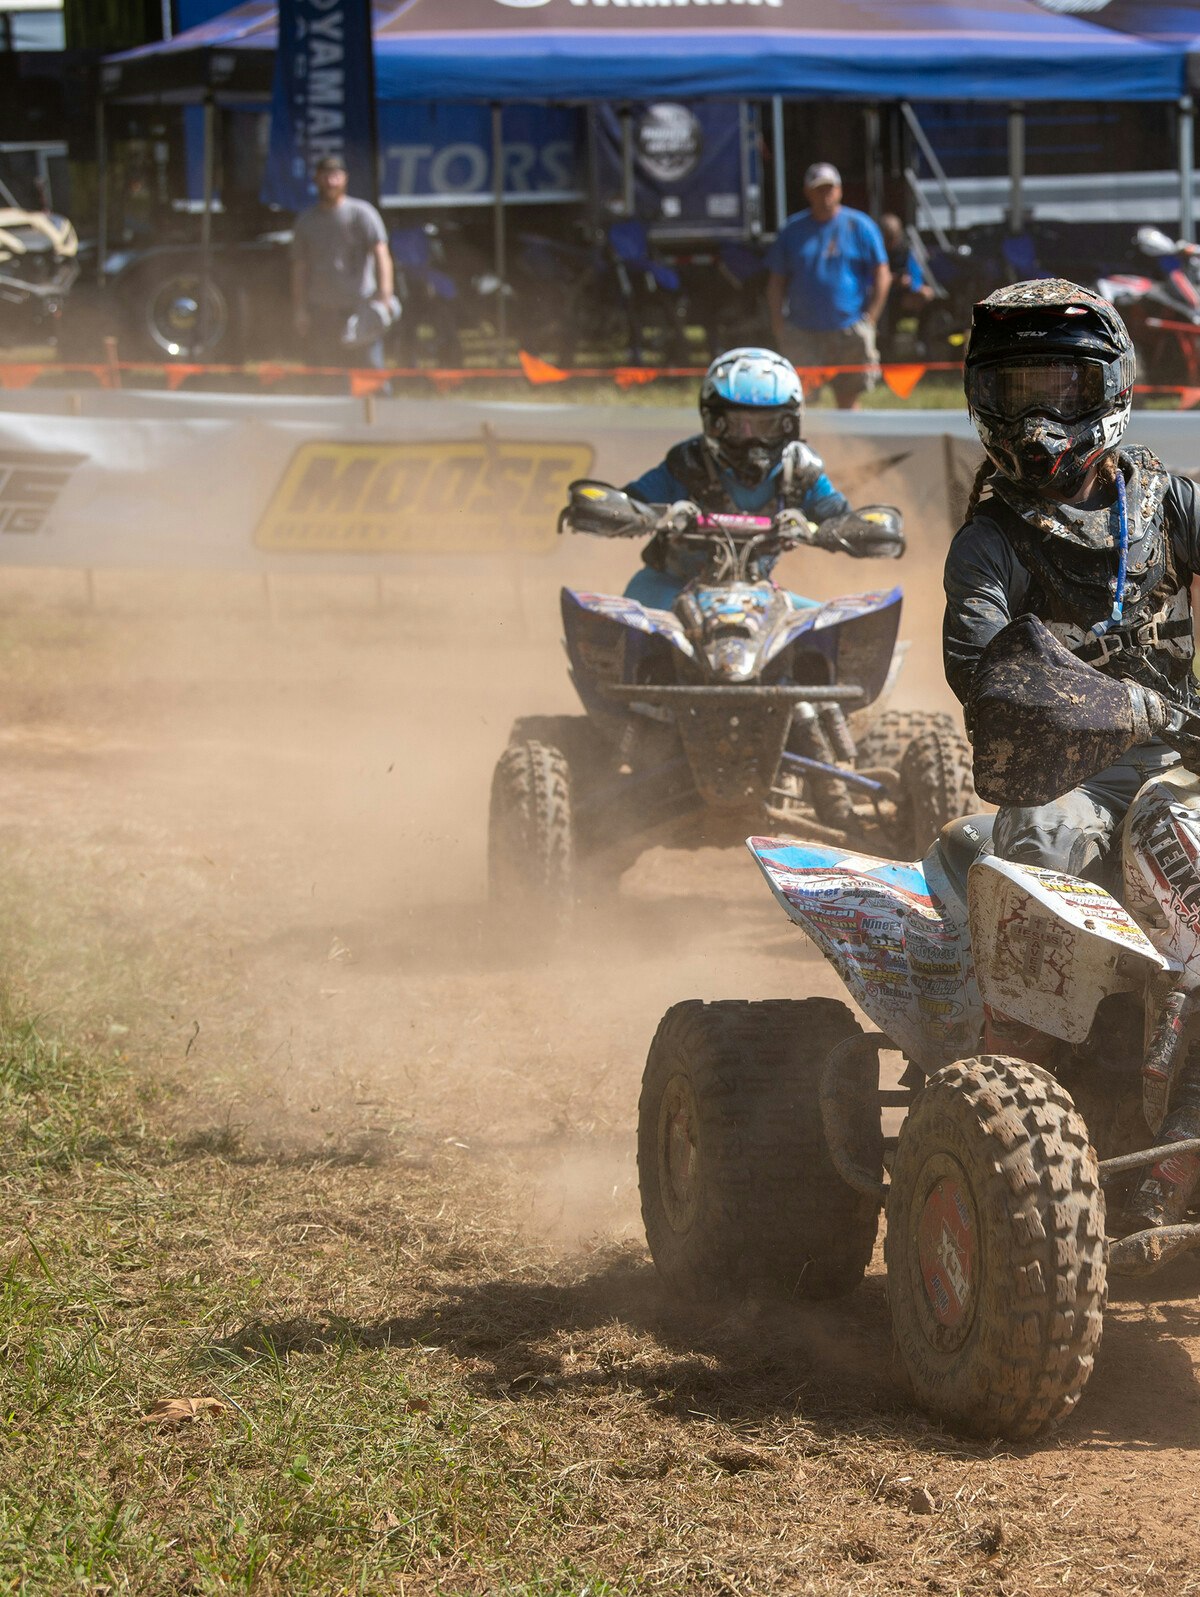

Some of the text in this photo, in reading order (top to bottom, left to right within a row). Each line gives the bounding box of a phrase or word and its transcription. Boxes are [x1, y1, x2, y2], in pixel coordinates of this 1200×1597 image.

[307, 10, 345, 180] YAMAH
[380, 142, 574, 193] TORS
[286, 456, 576, 516] MOOSE
[1015, 926, 1060, 946] JESUS
